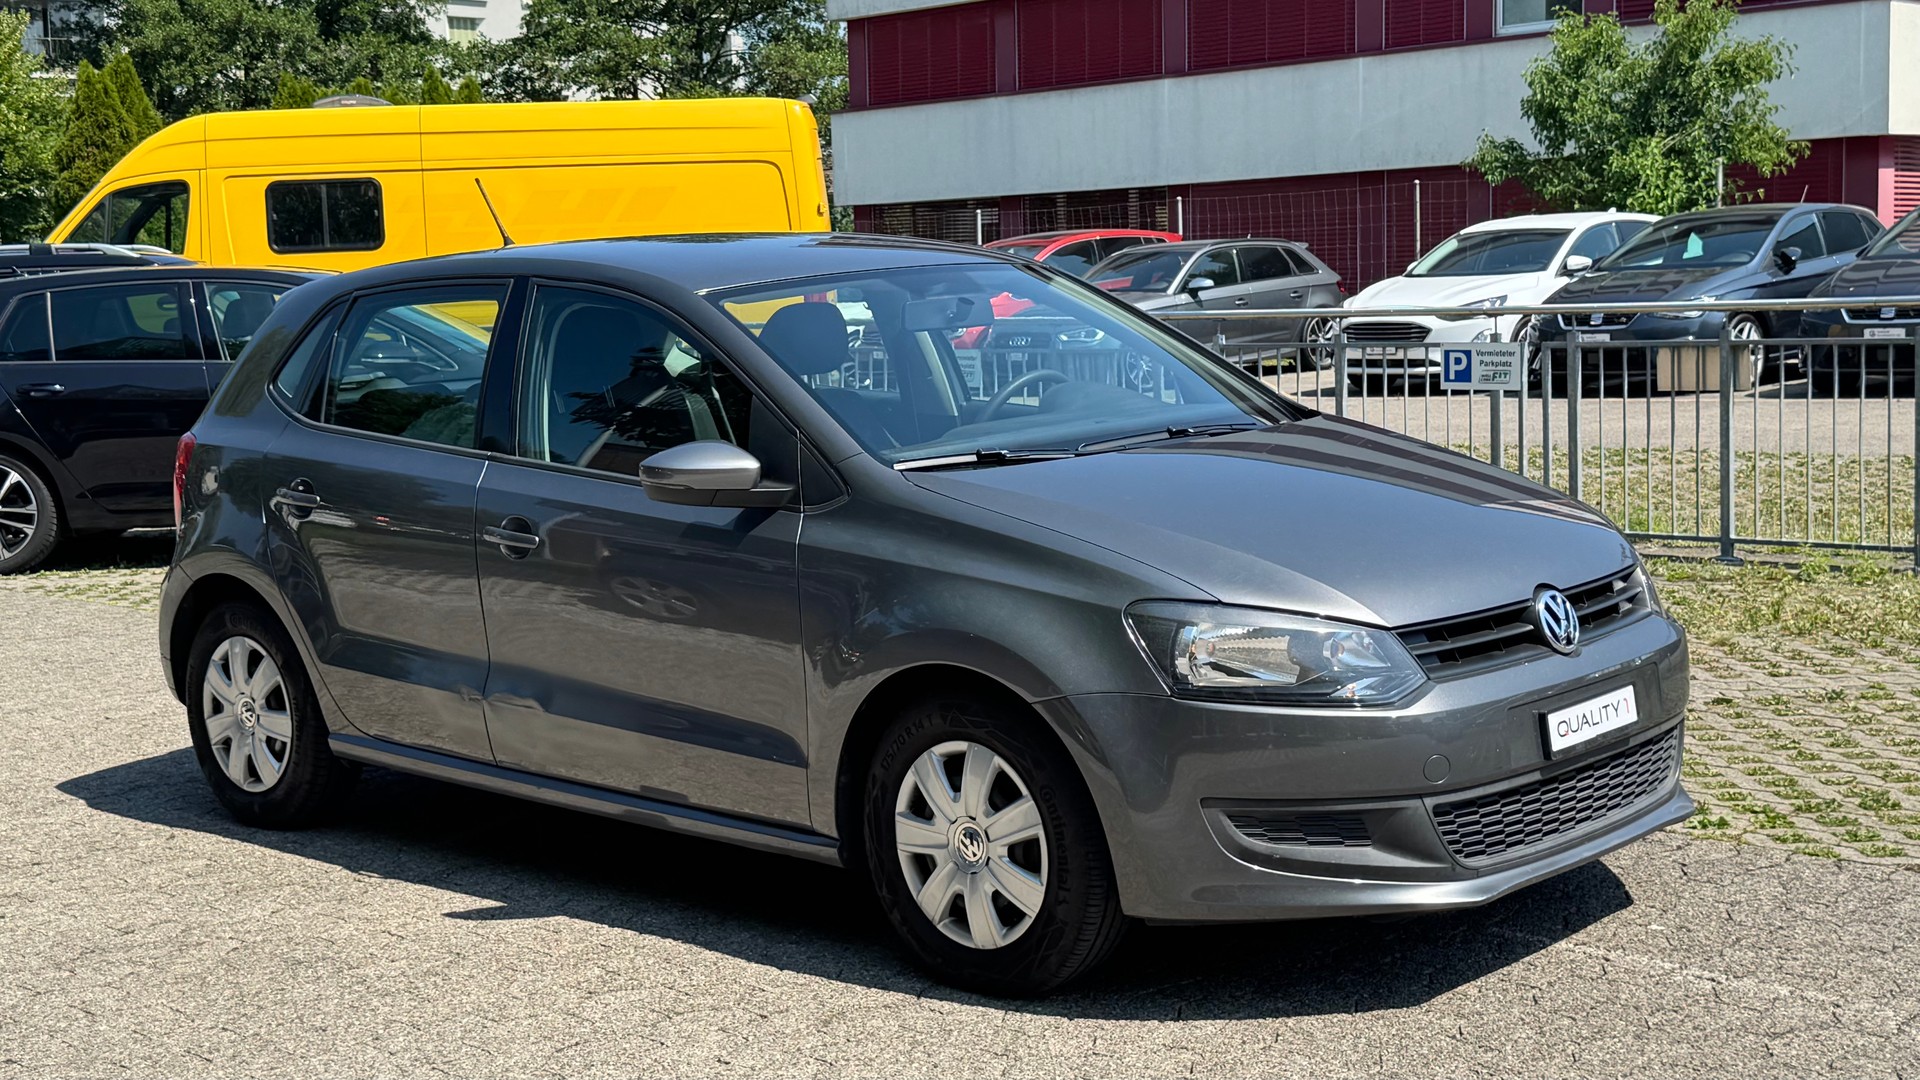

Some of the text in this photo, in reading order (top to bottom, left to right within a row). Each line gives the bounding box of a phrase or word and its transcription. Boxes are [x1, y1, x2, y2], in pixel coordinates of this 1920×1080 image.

[1475, 349, 1516, 357] Vermieteter
[1449, 352, 1468, 380] P
[1479, 360, 1512, 368] Parkplatz
[1492, 372, 1509, 381] FIT
[1556, 697, 1631, 738] QUALITY 1
